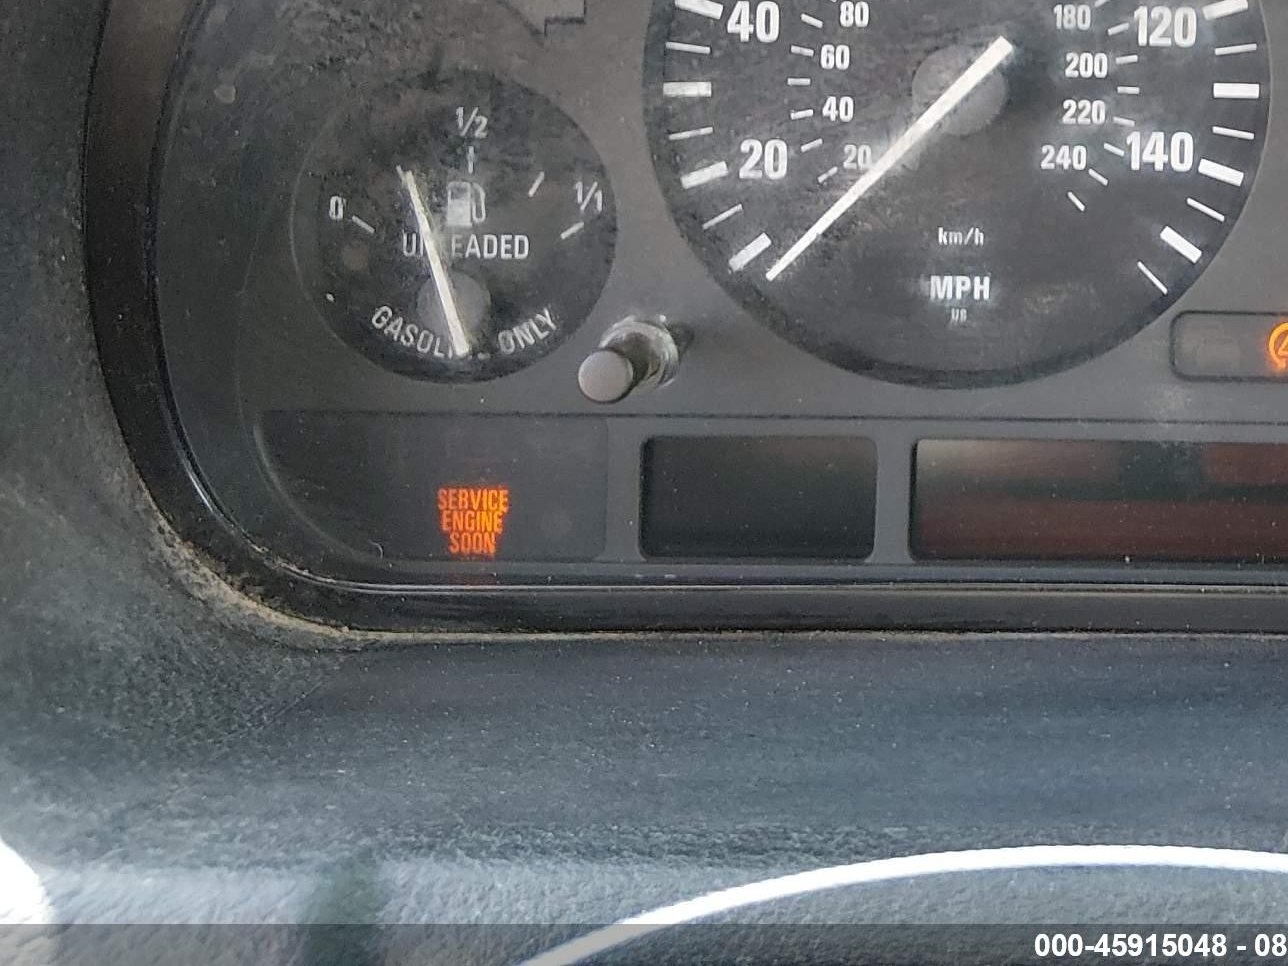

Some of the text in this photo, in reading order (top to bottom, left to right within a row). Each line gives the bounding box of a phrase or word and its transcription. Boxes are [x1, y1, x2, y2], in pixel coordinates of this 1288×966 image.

[726, 0, 780, 43] 40
[839, 0, 870, 27] 80
[1053, 4, 1092, 31] 180
[1133, 5, 1197, 47] 120
[820, 44, 850, 70] 60
[1065, 52, 1108, 78] 200
[822, 96, 854, 122] 40
[1063, 99, 1106, 125] 220
[739, 139, 788, 180] 20
[843, 144, 872, 170] 20
[1040, 145, 1087, 171] 240
[1126, 130, 1195, 172] 140
[402, 233, 529, 260] UEADED
[938, 227, 985, 246] km/h
[930, 275, 990, 301] MPH
[371, 305, 557, 361] GASOL ONLY
[438, 488, 509, 513] SERVICE
[442, 510, 503, 534] ENGINE
[449, 532, 497, 554] SOON
